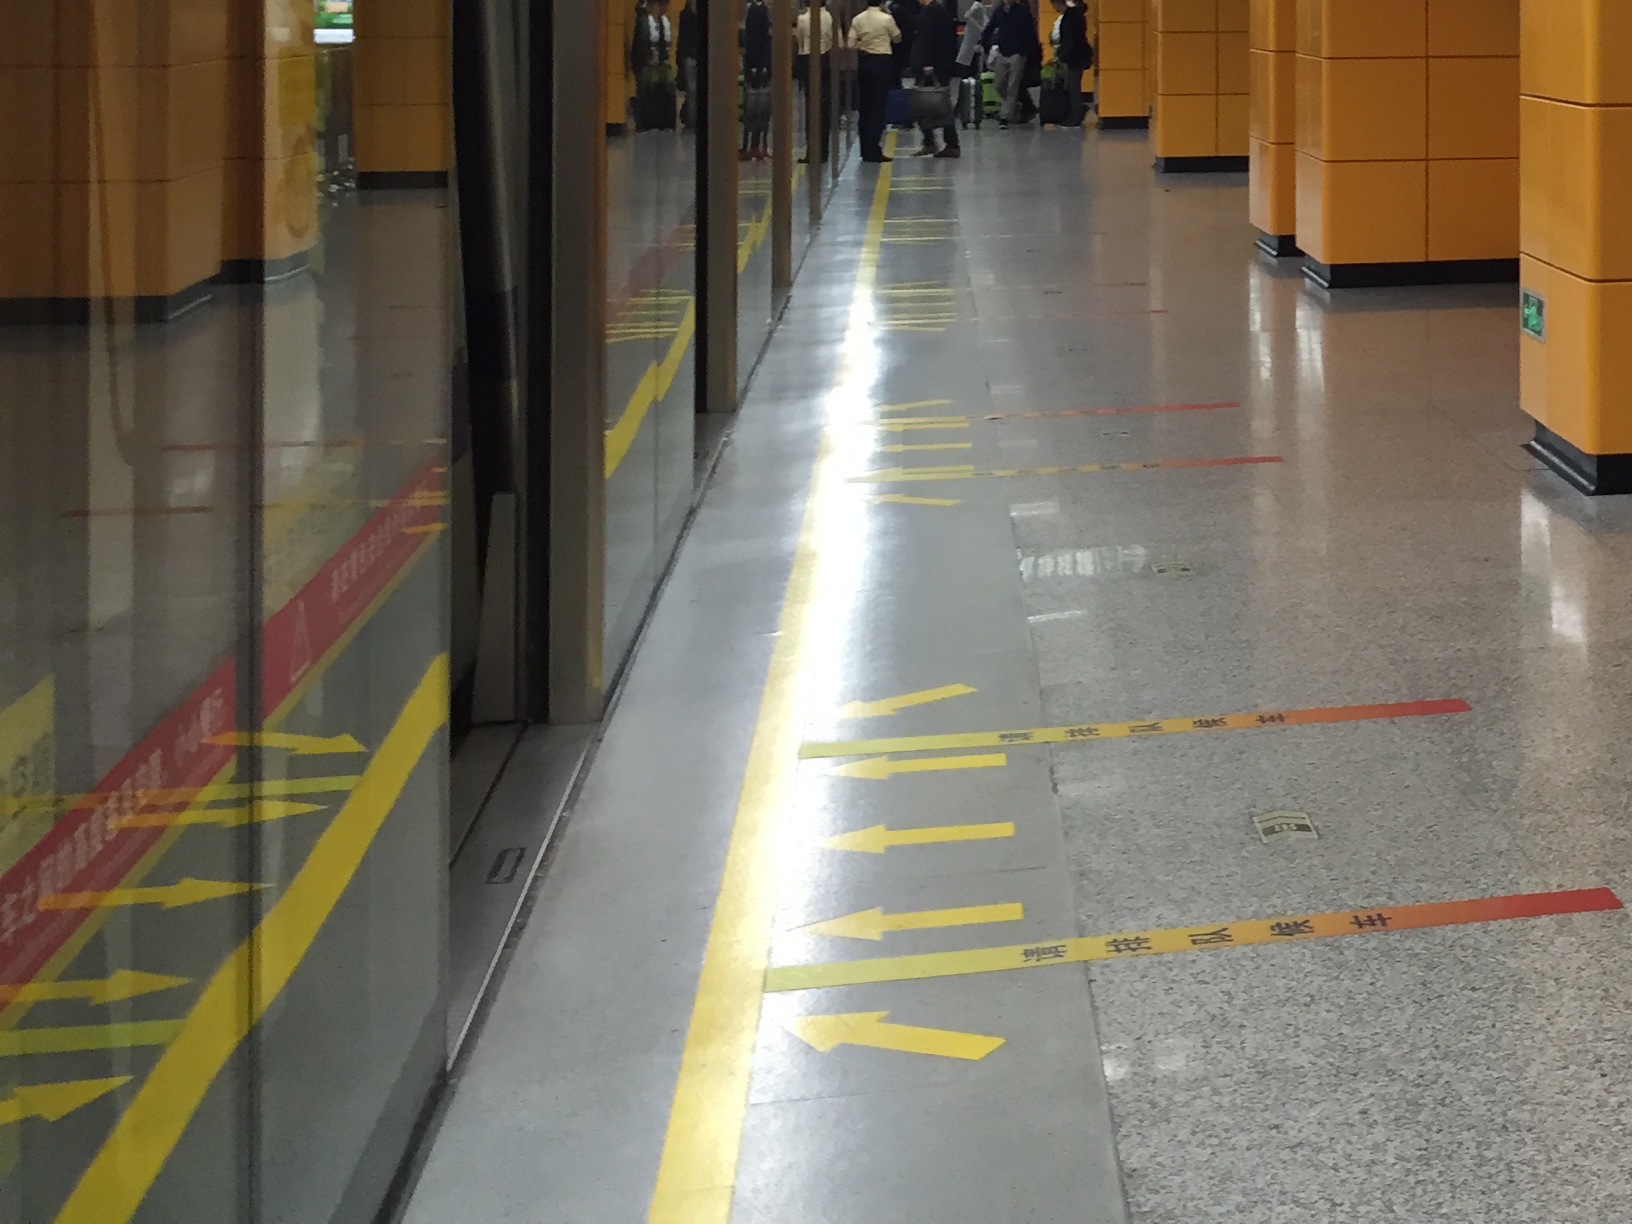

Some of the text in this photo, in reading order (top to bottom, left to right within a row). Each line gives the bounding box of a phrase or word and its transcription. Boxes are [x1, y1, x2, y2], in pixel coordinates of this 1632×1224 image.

[1022, 912, 1393, 963] 请排队候车
